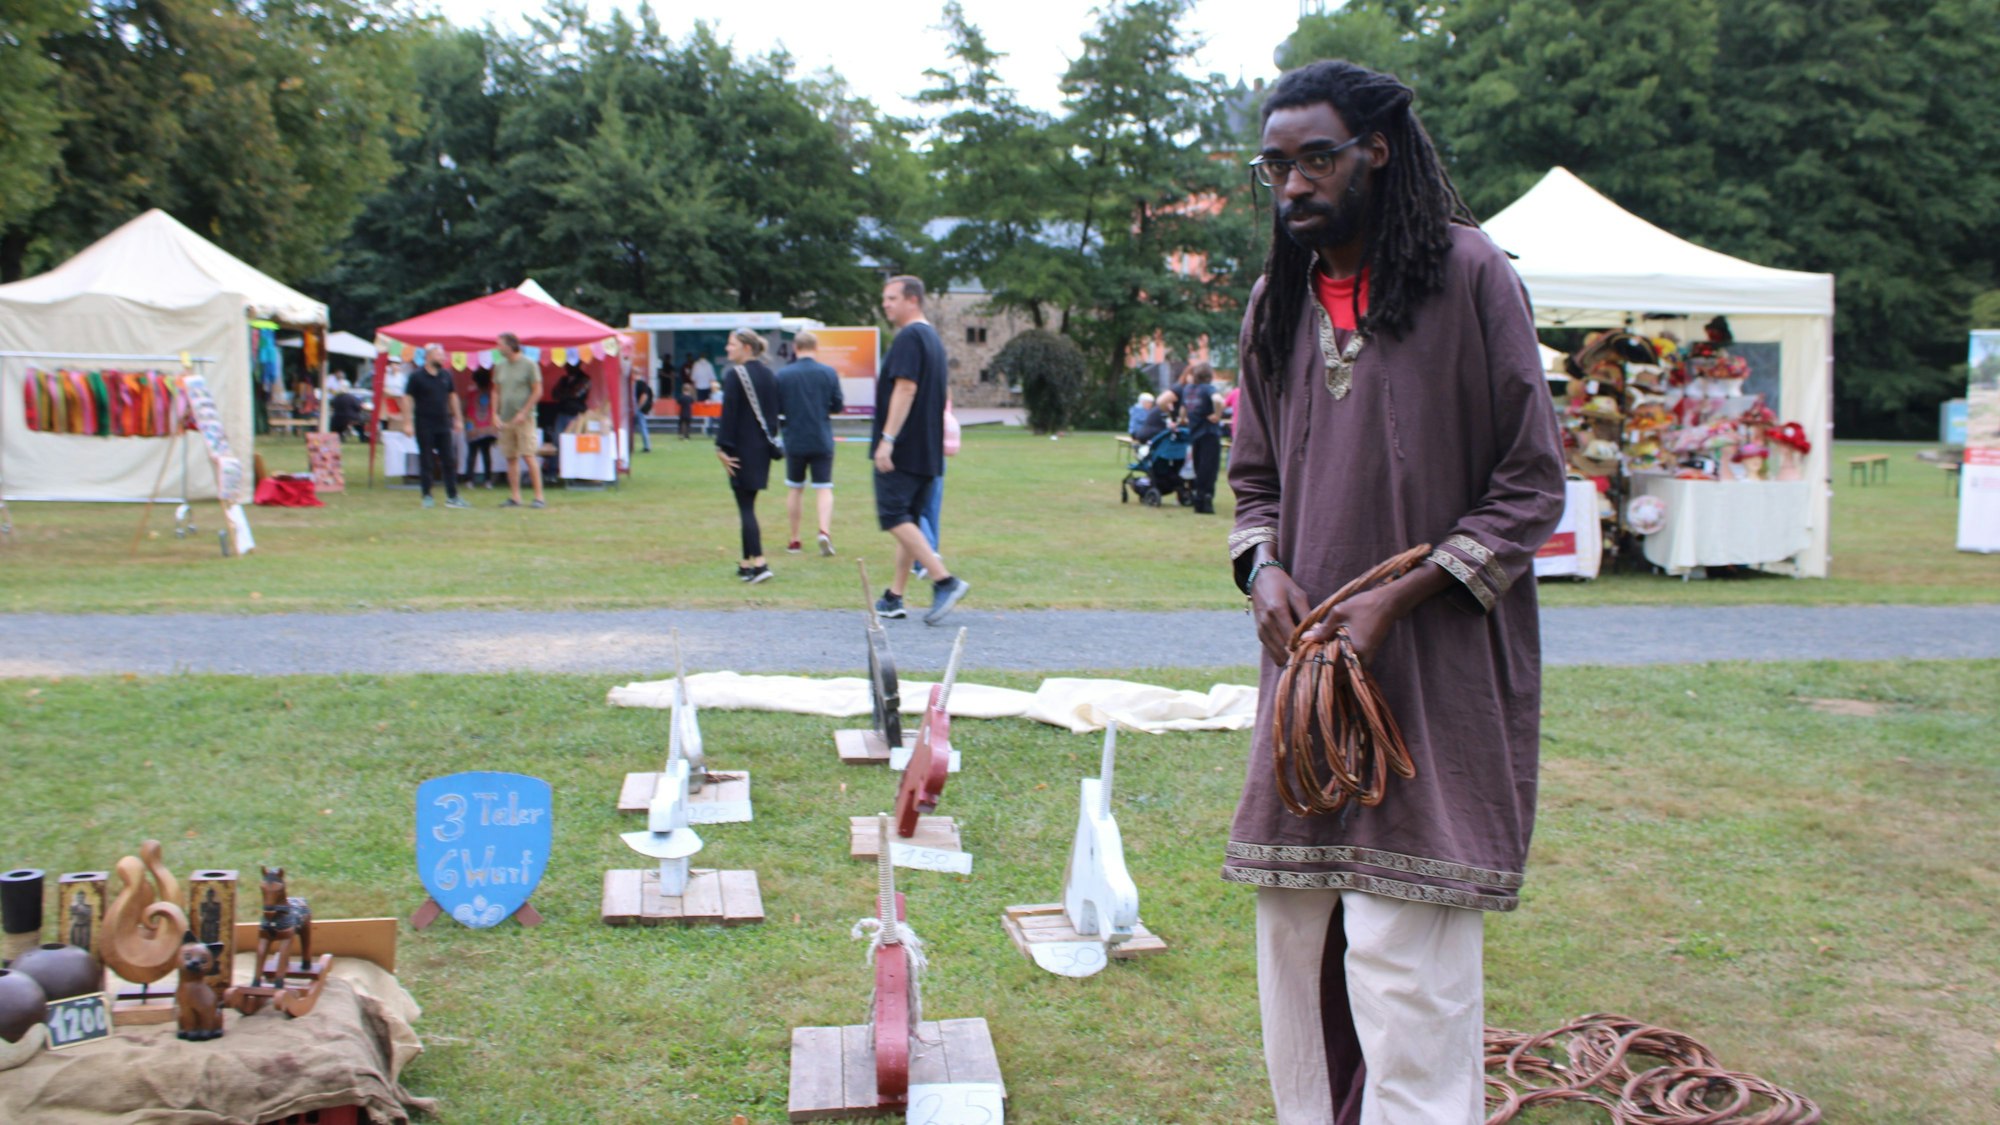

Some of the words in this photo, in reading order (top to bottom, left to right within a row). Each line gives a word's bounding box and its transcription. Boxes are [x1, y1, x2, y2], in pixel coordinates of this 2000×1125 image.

[432, 793, 468, 842] 3
[433, 848, 459, 891] 6
[899, 848, 950, 865] 150
[1050, 946, 1101, 969] 50
[916, 1089, 995, 1125] 25
